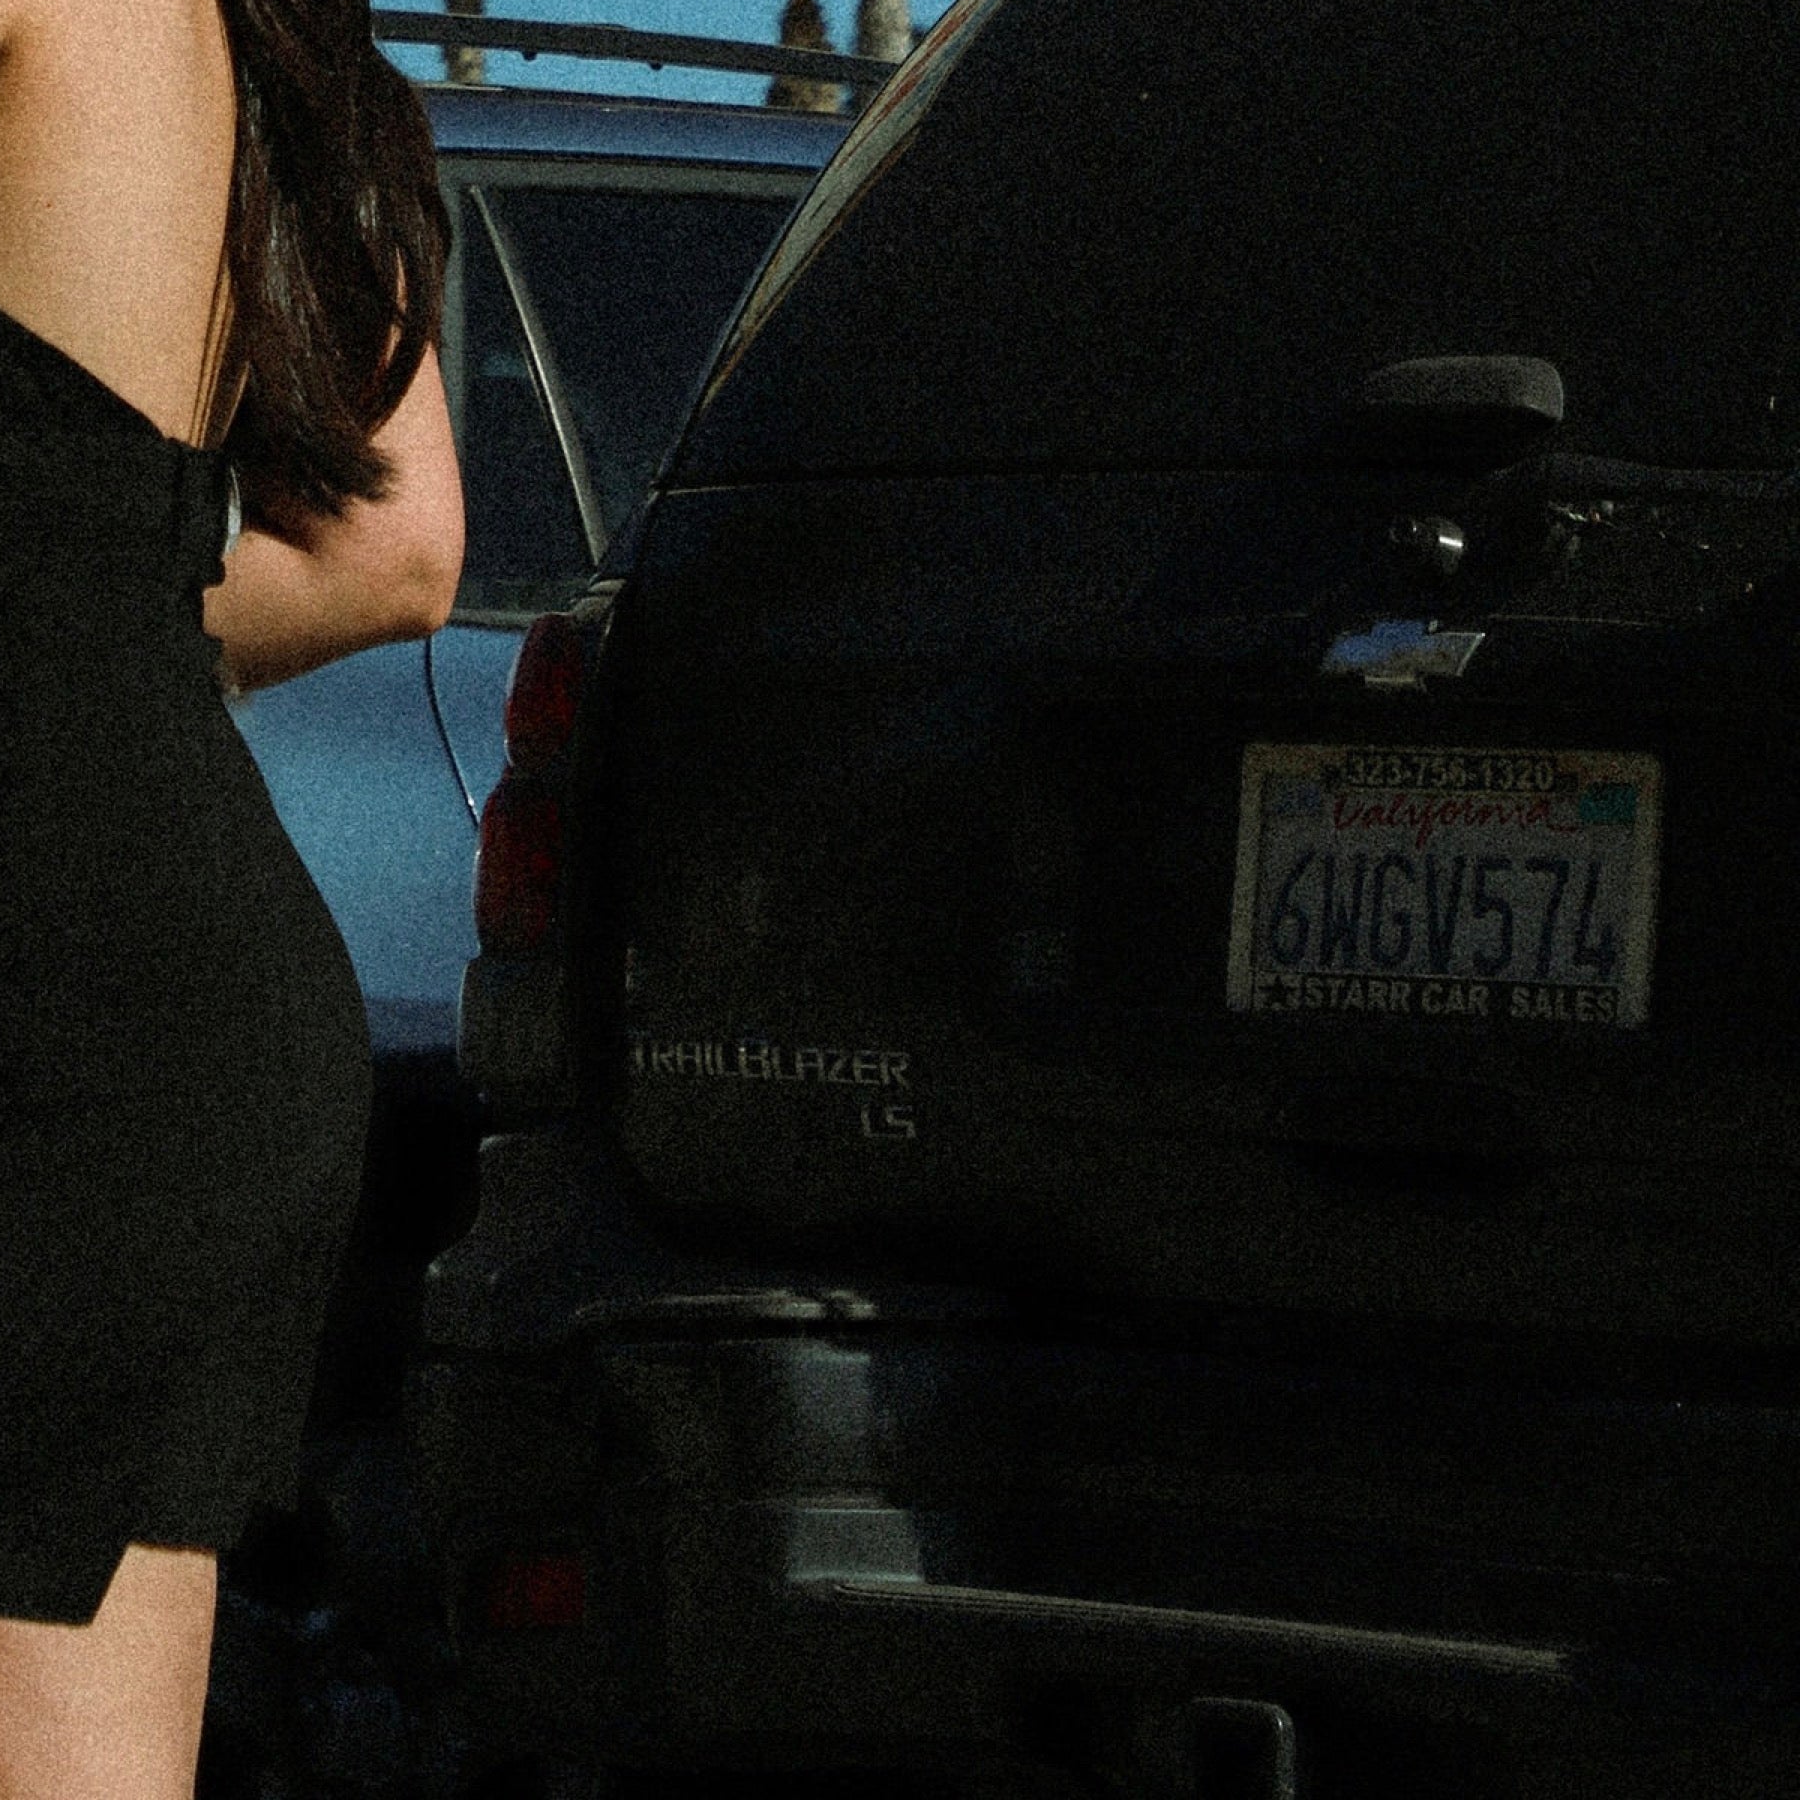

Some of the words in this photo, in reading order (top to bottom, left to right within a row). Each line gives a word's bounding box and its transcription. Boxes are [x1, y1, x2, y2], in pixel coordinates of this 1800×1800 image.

[1332, 791, 1577, 849] California
[1269, 848, 1618, 984] 6WGV574
[1303, 976, 1411, 1013] STARR
[1419, 980, 1490, 1017] CAR
[1508, 985, 1616, 1024] SALES
[632, 1040, 912, 1086] TRAILBLAZER
[860, 1103, 917, 1139] LS
